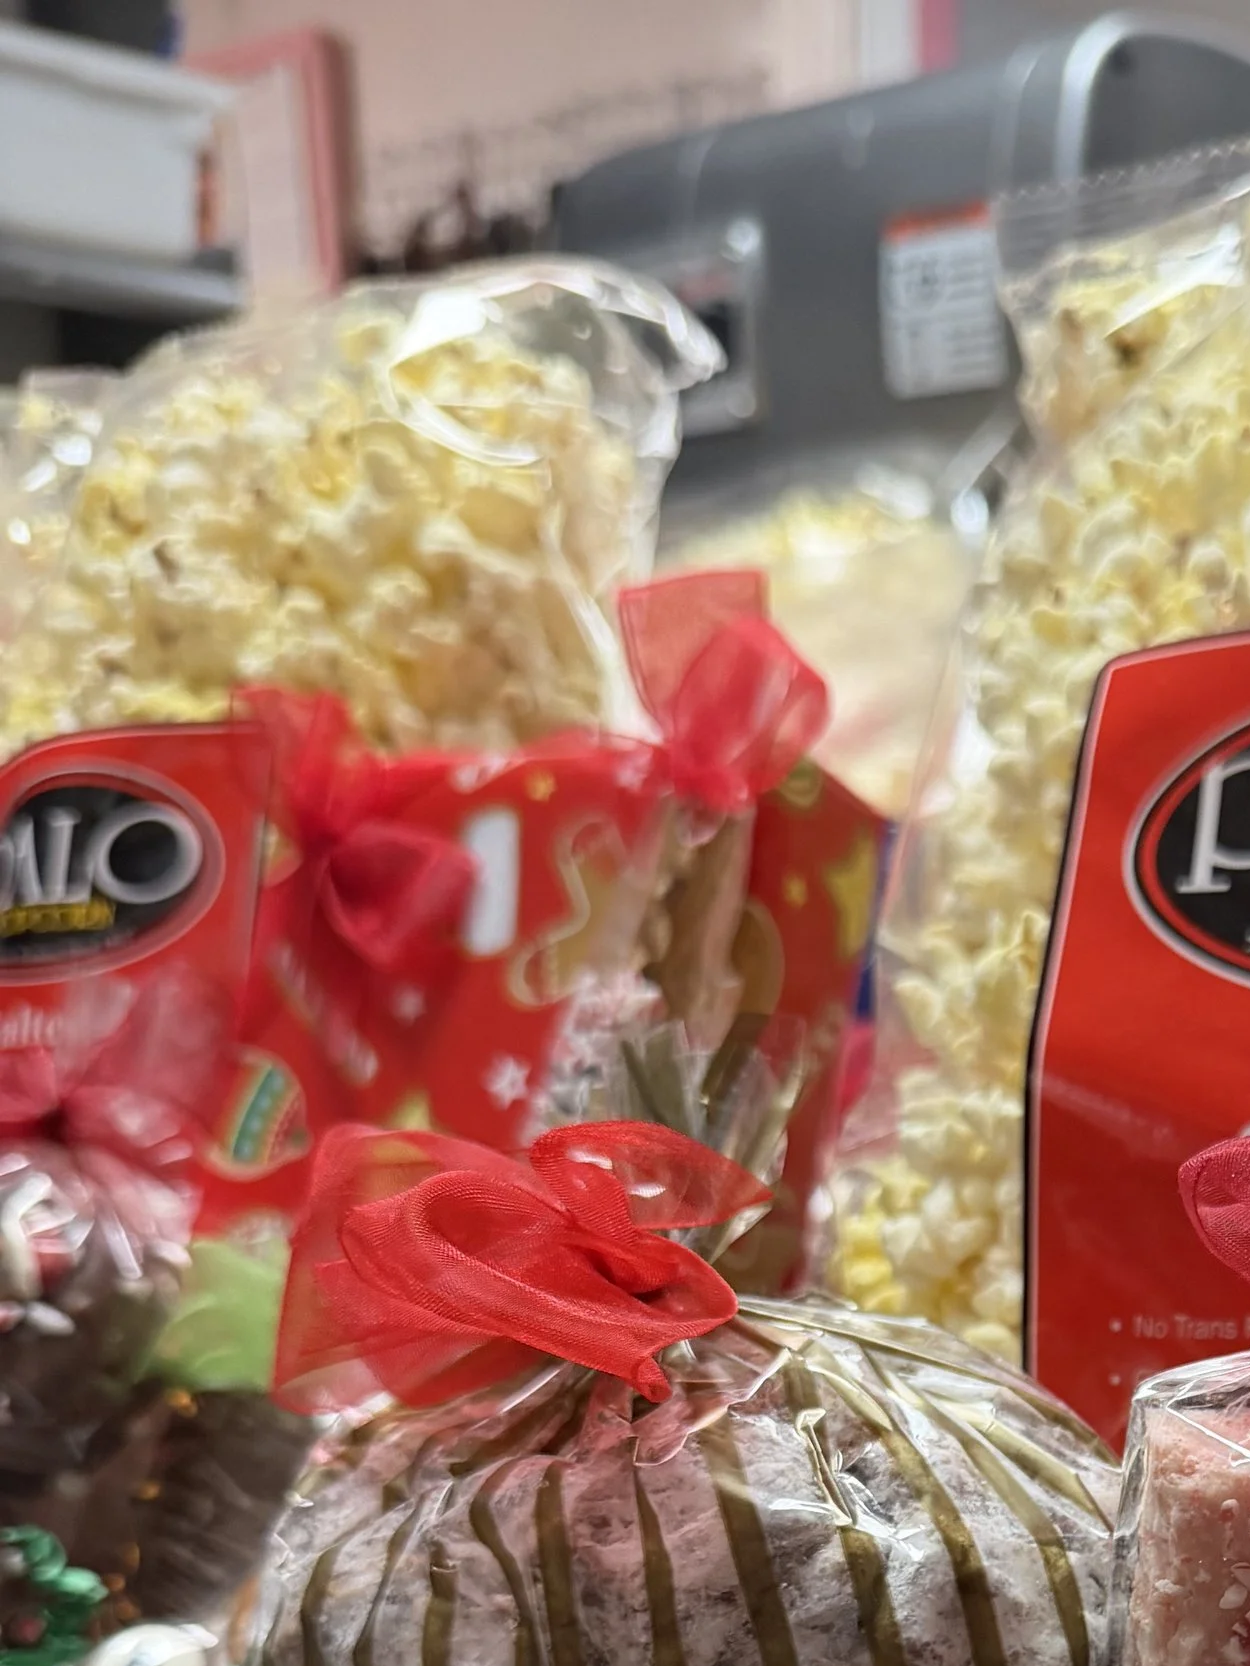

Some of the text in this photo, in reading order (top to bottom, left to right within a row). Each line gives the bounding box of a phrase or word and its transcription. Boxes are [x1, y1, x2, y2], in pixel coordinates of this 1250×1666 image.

[0, 800, 203, 910] ALO
[1132, 1313, 1167, 1338] No
[1173, 1315, 1237, 1340] Trans
